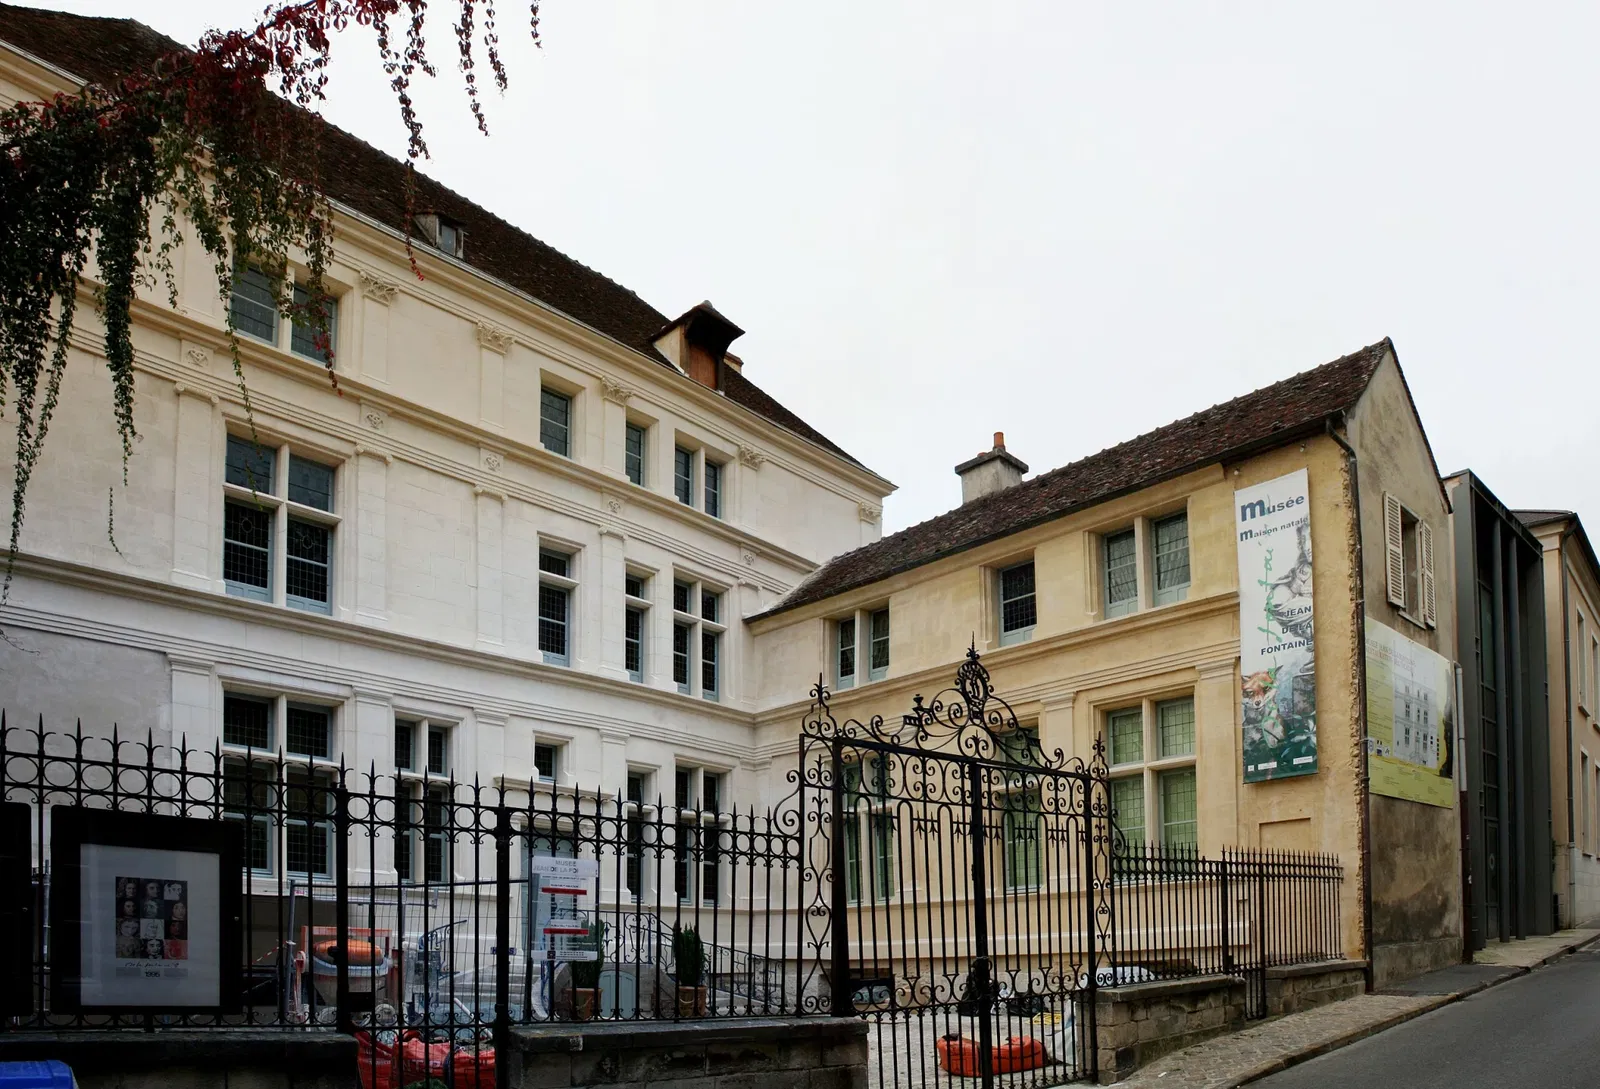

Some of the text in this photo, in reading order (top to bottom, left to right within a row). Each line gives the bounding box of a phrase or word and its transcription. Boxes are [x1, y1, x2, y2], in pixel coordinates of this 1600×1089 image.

[1280, 516, 1309, 530] natale
[1286, 605, 1311, 617] JEAN
[1282, 621, 1312, 634] DE LA
[1261, 638, 1312, 656] FONTAINE
